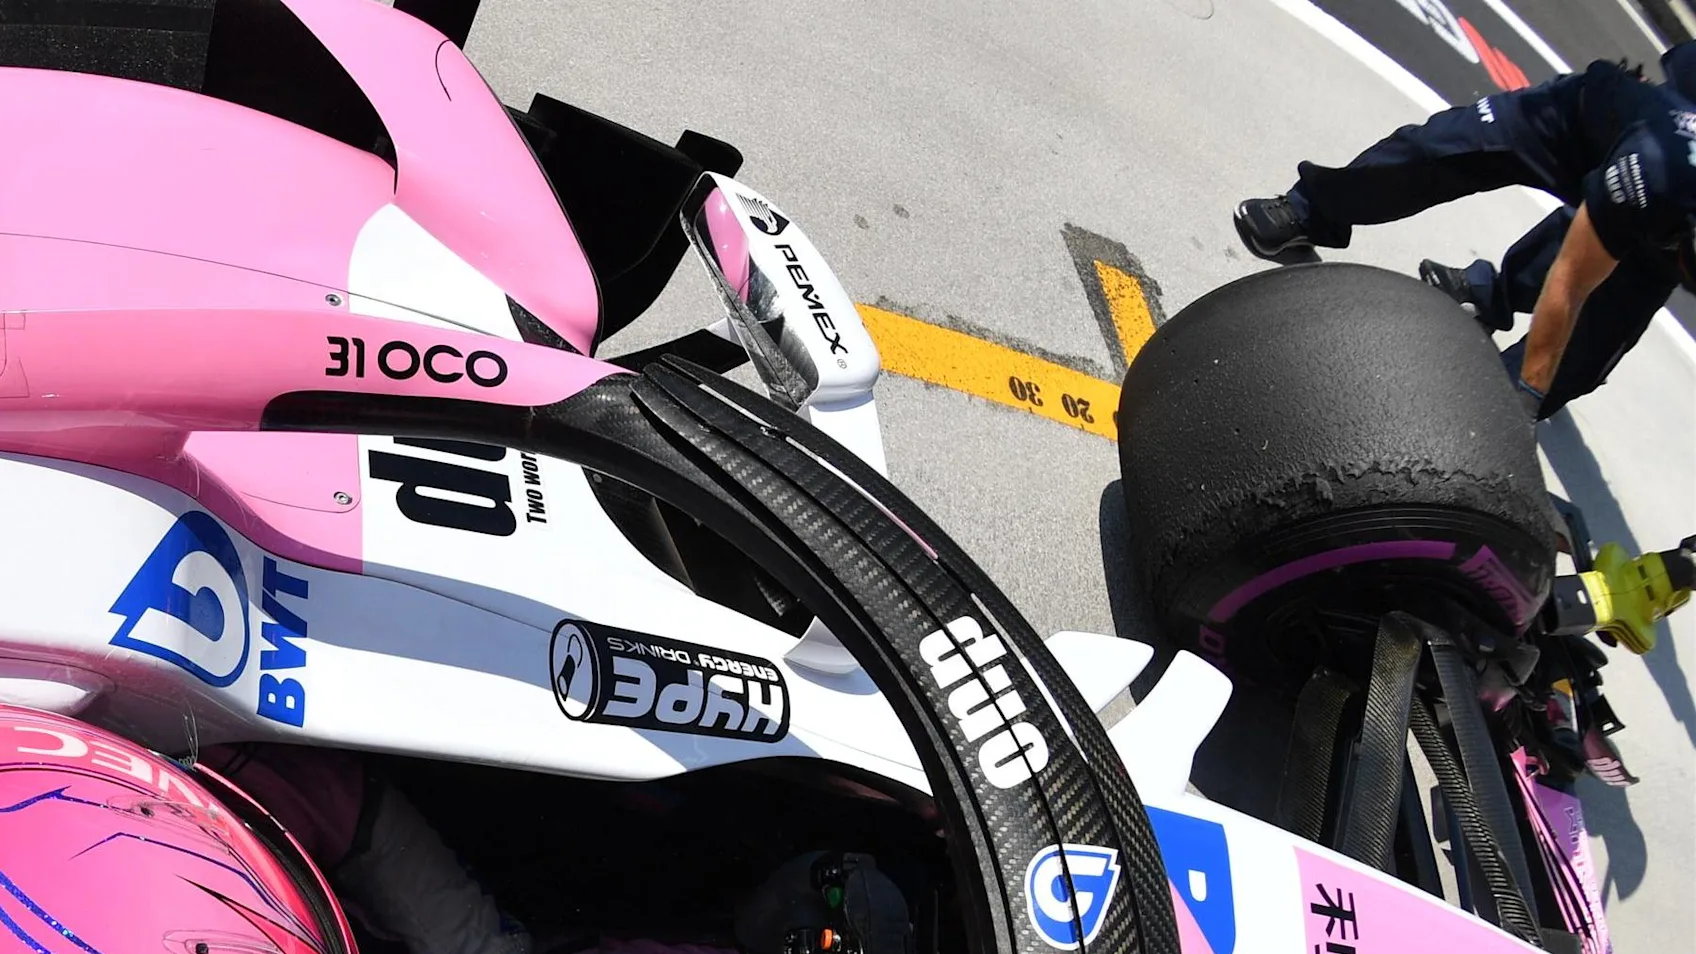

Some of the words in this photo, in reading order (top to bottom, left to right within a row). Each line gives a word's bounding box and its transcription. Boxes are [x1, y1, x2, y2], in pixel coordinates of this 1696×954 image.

[774, 244, 849, 355] PEMEX
[325, 336, 366, 379] 31
[377, 340, 509, 388] OCO
[1008, 375, 1044, 407] 30
[1061, 393, 1095, 424] 20
[256, 554, 310, 729] BWT
[606, 636, 691, 664] DRINKS
[697, 652, 779, 682] ENERGY
[602, 655, 784, 736] HYPE
[918, 615, 1050, 790] duo
